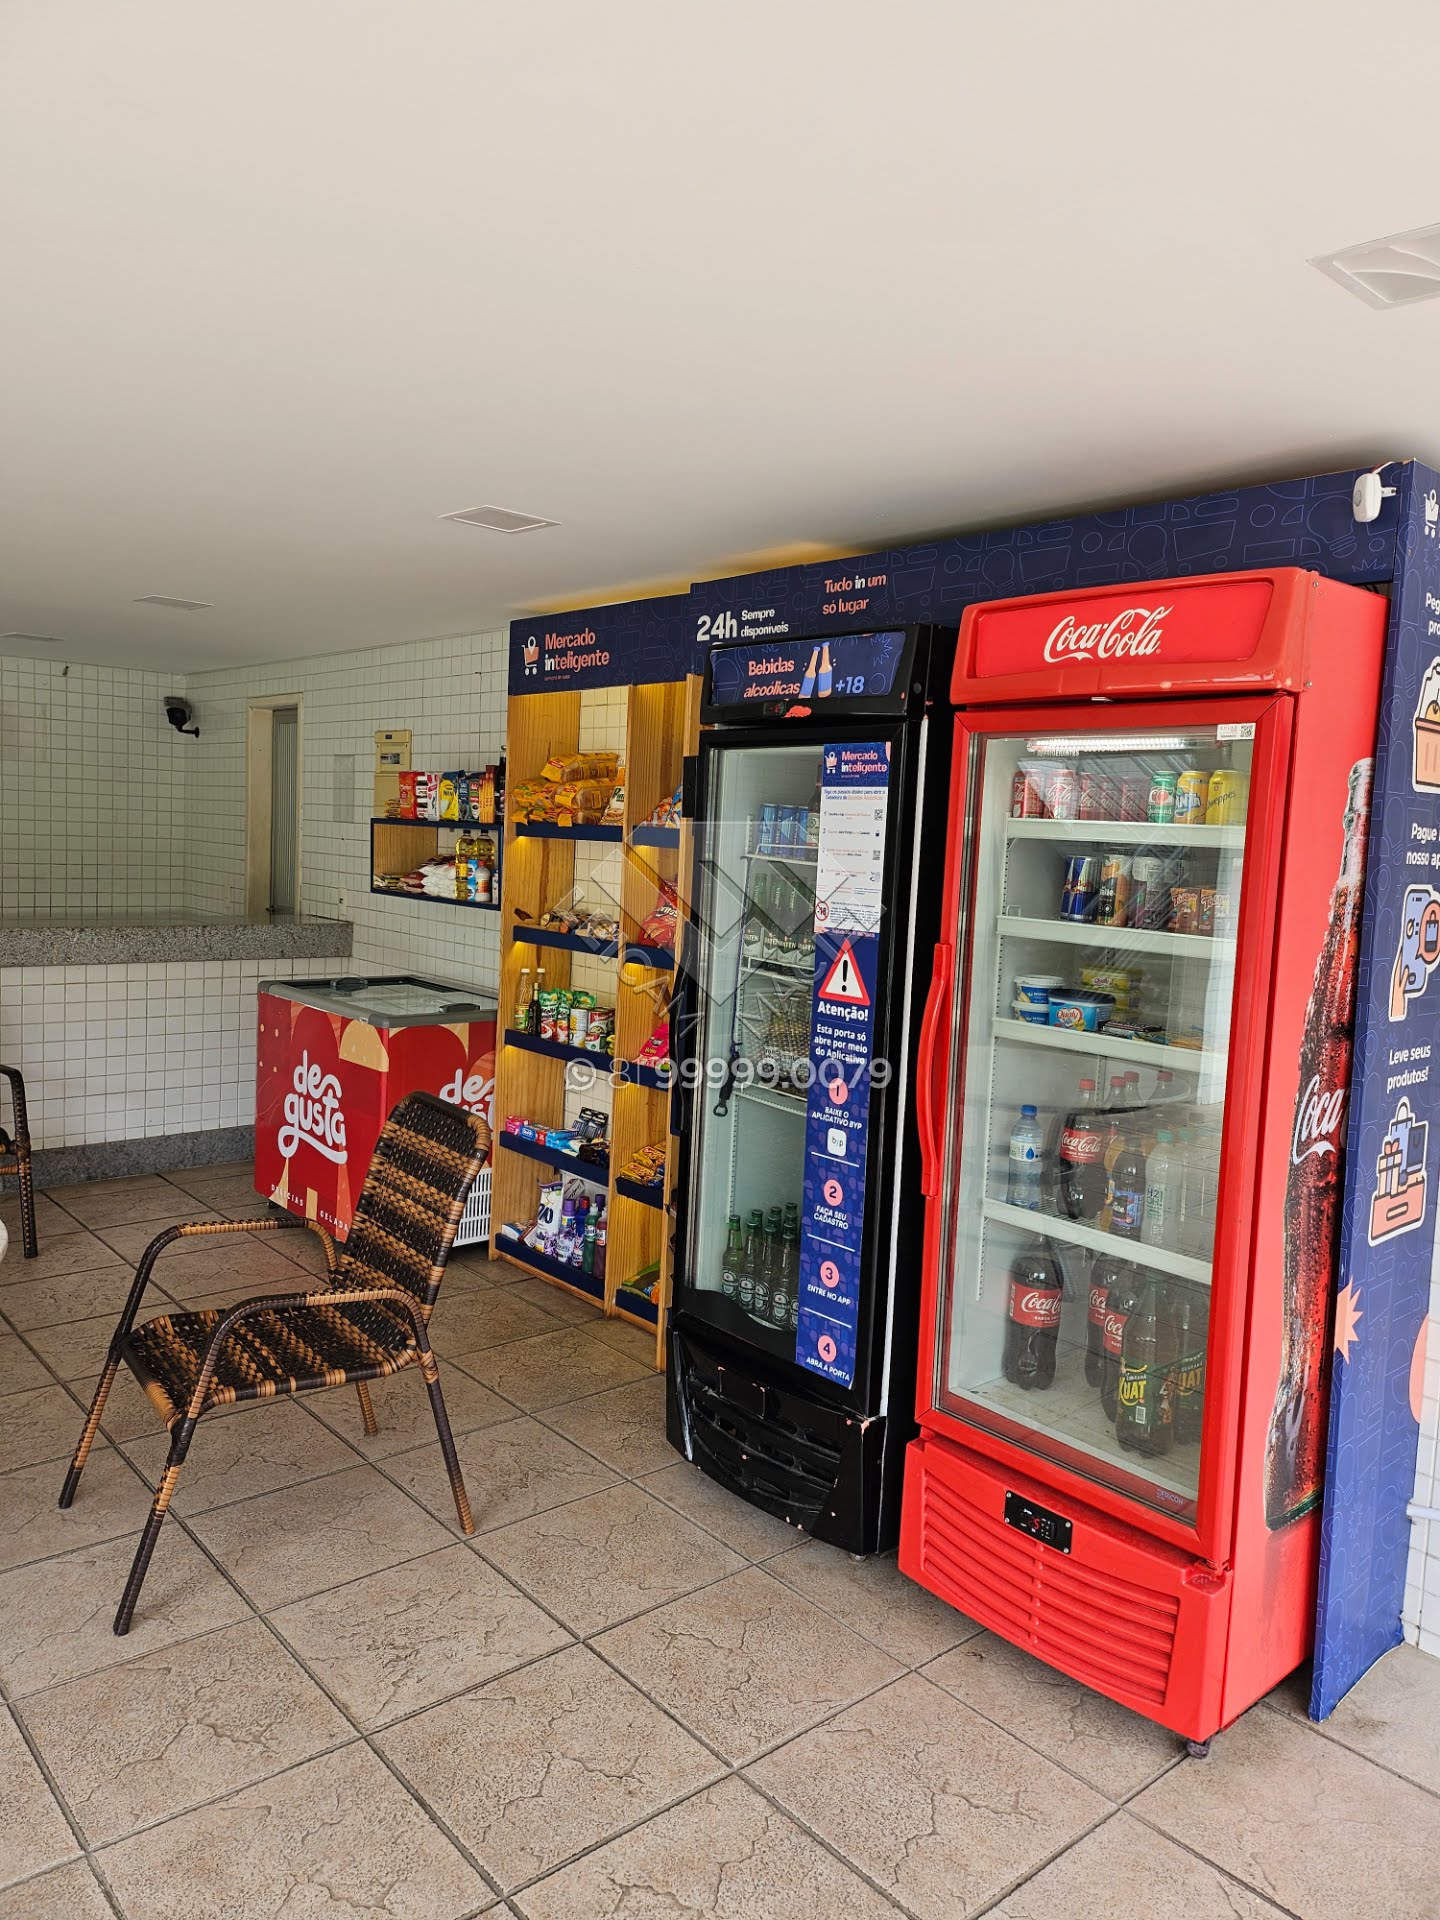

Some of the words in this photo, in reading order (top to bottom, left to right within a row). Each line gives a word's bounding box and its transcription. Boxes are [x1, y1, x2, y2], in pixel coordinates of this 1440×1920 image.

[824, 576, 852, 594] Tudo
[854, 575, 866, 589] in
[867, 574, 887, 587] um
[741, 608, 776, 621] Sempre
[822, 599, 837, 615] só
[838, 597, 869, 615] lugar
[696, 611, 738, 642] 24h
[740, 621, 789, 639] disponíveis
[1043, 604, 1175, 663] Coca-Cola
[545, 627, 596, 650] Mercado
[544, 649, 610, 673] inteligente
[748, 657, 795, 677] Bebidas
[743, 680, 801, 699] alcoólicas
[835, 675, 865, 695] +18
[841, 750, 878, 761] Mercado
[841, 761, 888, 774] inteligente
[1411, 823, 1438, 844] Pague
[1406, 851, 1430, 866] nosso
[817, 1000, 869, 1022] Atenção!
[1056, 1010, 1078, 1020] Qualy
[817, 1024, 832, 1036] Esta
[834, 1027, 856, 1039] porta
[856, 1030, 866, 1041] só
[814, 1035, 832, 1046] abre
[832, 1039, 846, 1050] por
[848, 1042, 868, 1054] meio
[816, 1046, 826, 1056] do
[826, 1049, 865, 1065] Aplicativo
[1389, 1049, 1409, 1066] Leve
[1410, 1045, 1431, 1060] seus
[294, 1049, 342, 1100] de
[1387, 1066, 1430, 1094] produtos!
[440, 1068, 496, 1104] de
[836, 1084, 840, 1096] 1
[812, 1112, 850, 1126] APLICATIVO
[849, 1120, 862, 1130] BYP
[824, 1106, 842, 1118] BAIXE
[843, 1110, 850, 1118] O
[278, 1089, 348, 1164] gusta
[832, 1136, 844, 1148] byp
[1062, 1132, 1102, 1153] Coca-Cola
[829, 1186, 838, 1199] 2
[320, 1210, 350, 1232] GELADA
[814, 1213, 849, 1230] CADASTRO
[816, 1205, 834, 1218] FAÇA
[834, 1208, 847, 1220] SEU
[825, 1266, 833, 1280] 3
[807, 1284, 826, 1298] ENTRE
[826, 1291, 837, 1300] NO
[837, 1294, 851, 1306] APP
[822, 1342, 831, 1354] 4
[806, 1356, 823, 1370] ABRA
[823, 1363, 828, 1371] A
[828, 1366, 850, 1381] PORTA
